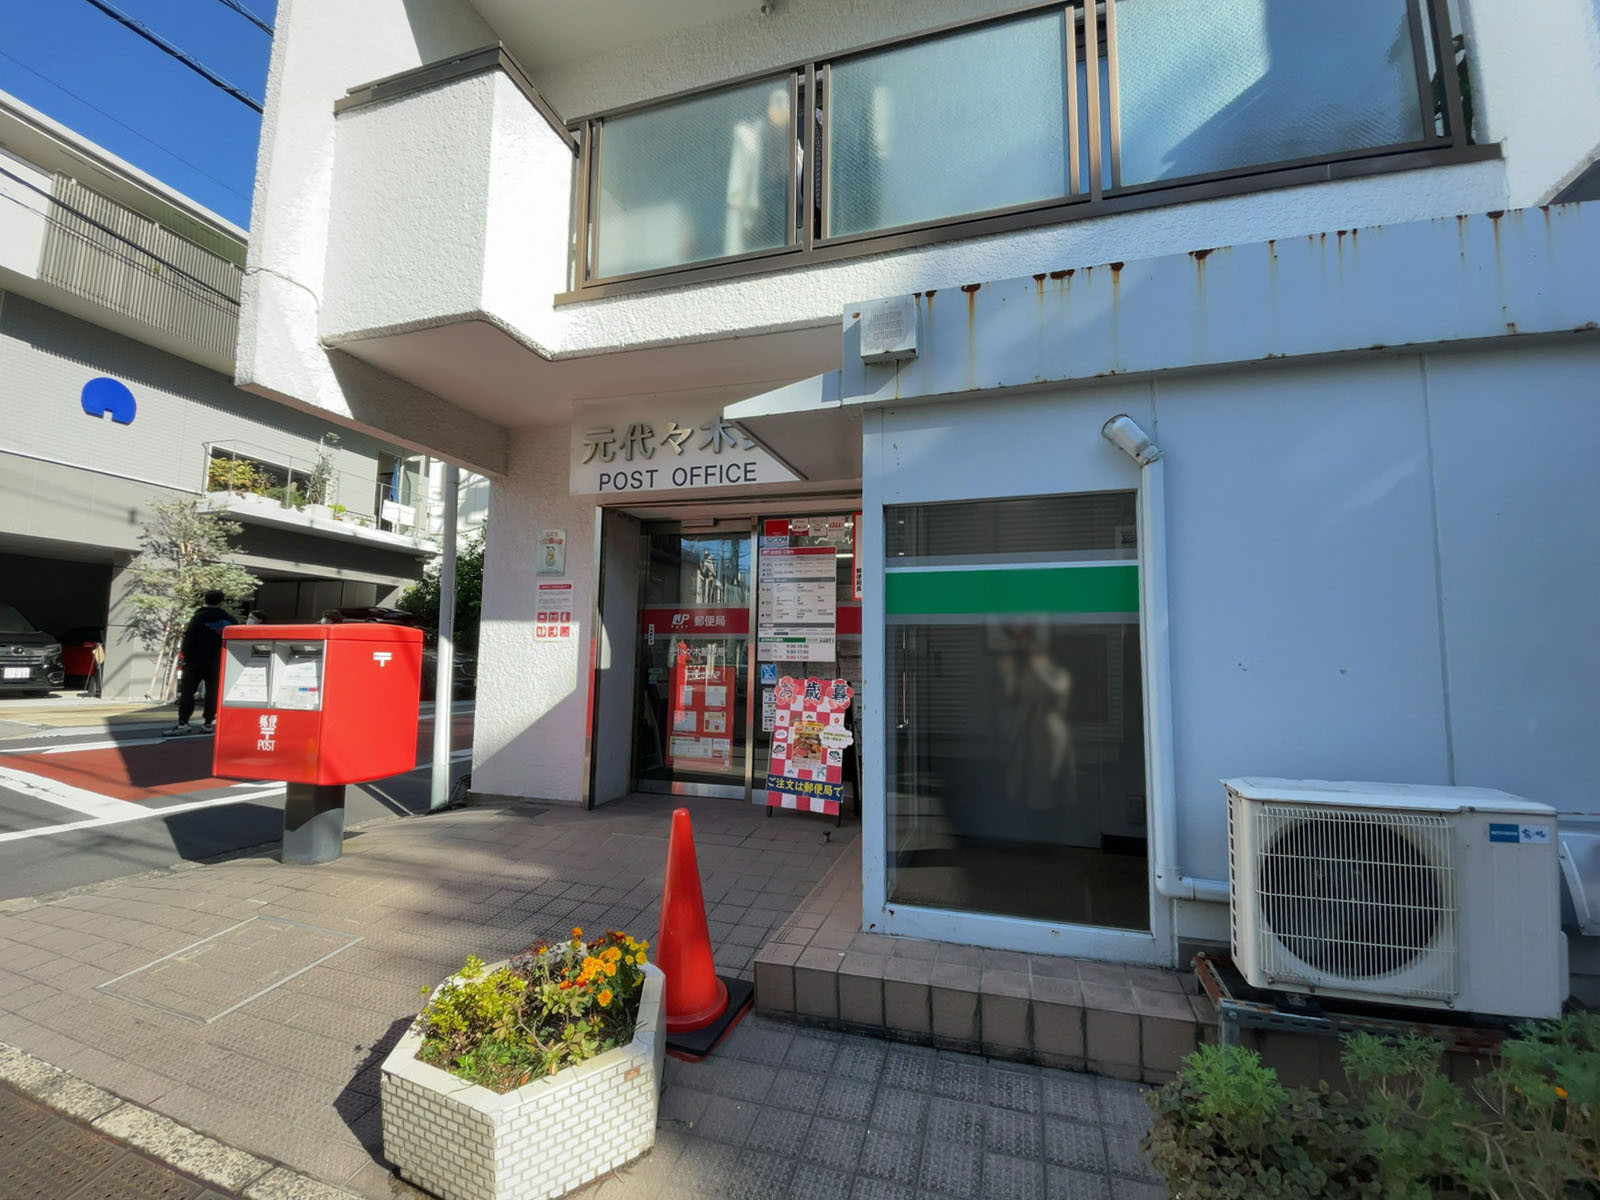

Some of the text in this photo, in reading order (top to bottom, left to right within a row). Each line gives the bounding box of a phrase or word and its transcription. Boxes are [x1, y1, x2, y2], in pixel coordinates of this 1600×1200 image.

[582, 417, 758, 464] 元代々木
[599, 462, 757, 492] POST OFFICE
[694, 615, 726, 627] 郵便局
[259, 714, 278, 729] 郵便
[257, 740, 276, 752] POST
[767, 776, 845, 798] ご注文は郵便局で
